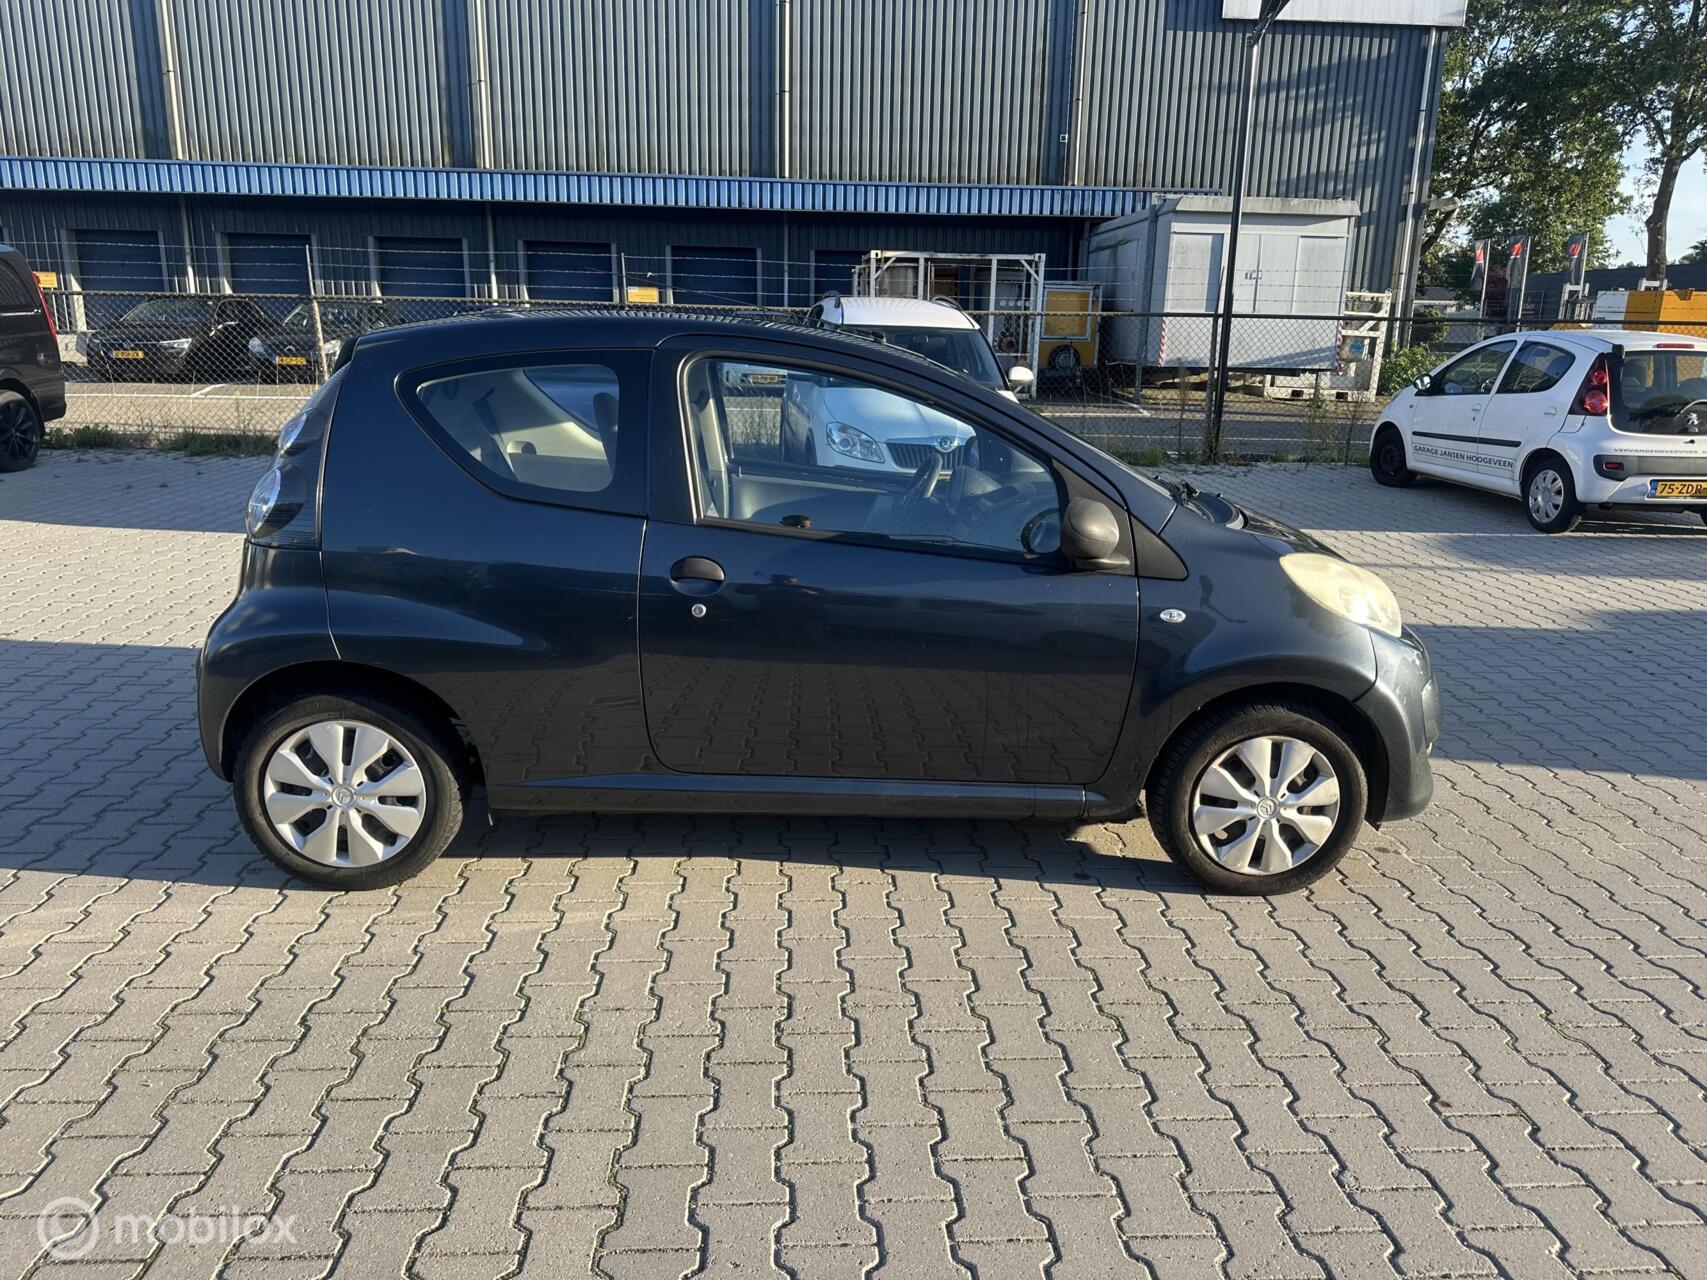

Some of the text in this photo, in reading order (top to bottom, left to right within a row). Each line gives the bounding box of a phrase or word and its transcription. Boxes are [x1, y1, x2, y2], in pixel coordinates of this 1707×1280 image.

[1413, 445, 1514, 469] GARAGE JANSEN HOOGEVEEN
